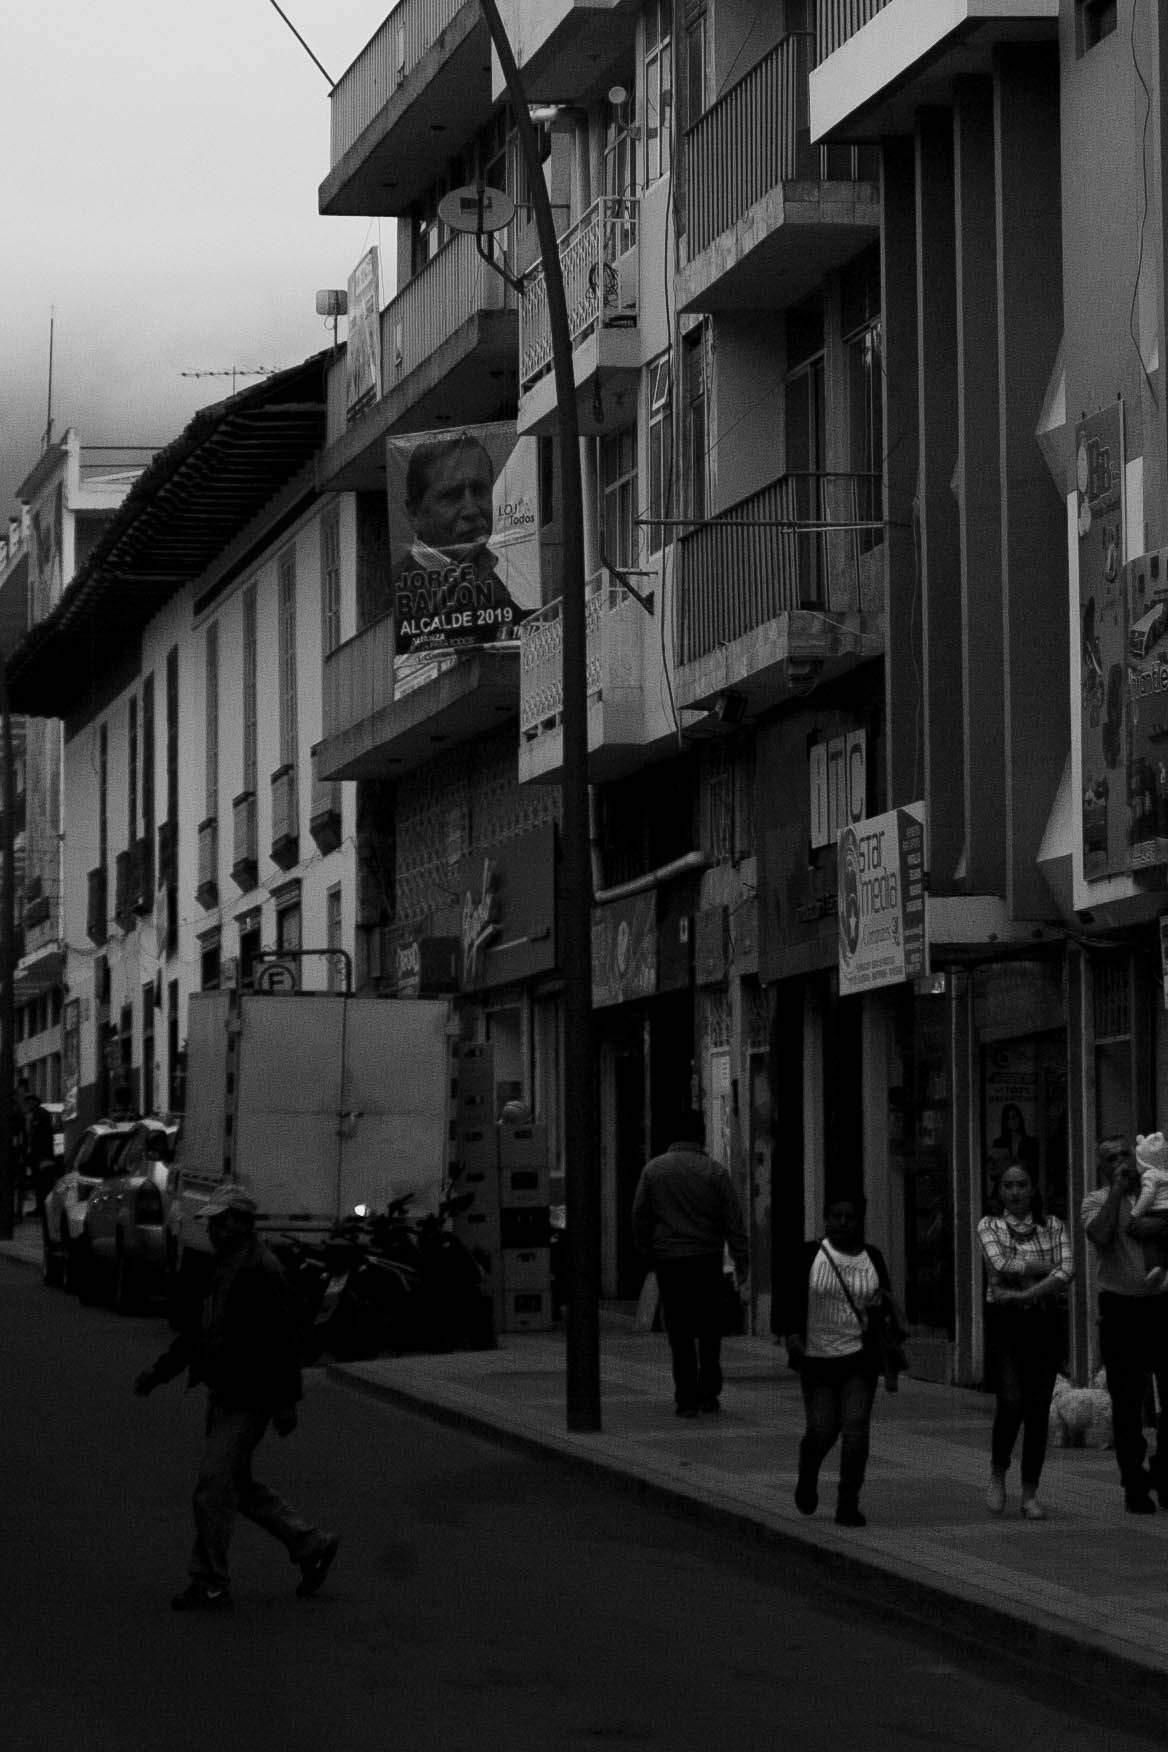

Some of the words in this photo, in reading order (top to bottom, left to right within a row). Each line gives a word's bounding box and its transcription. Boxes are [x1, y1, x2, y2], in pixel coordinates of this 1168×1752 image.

[509, 513, 535, 526] Todos
[395, 563, 475, 590] JORGE
[399, 610, 473, 636] ALCALDE
[476, 606, 513, 626] 2019
